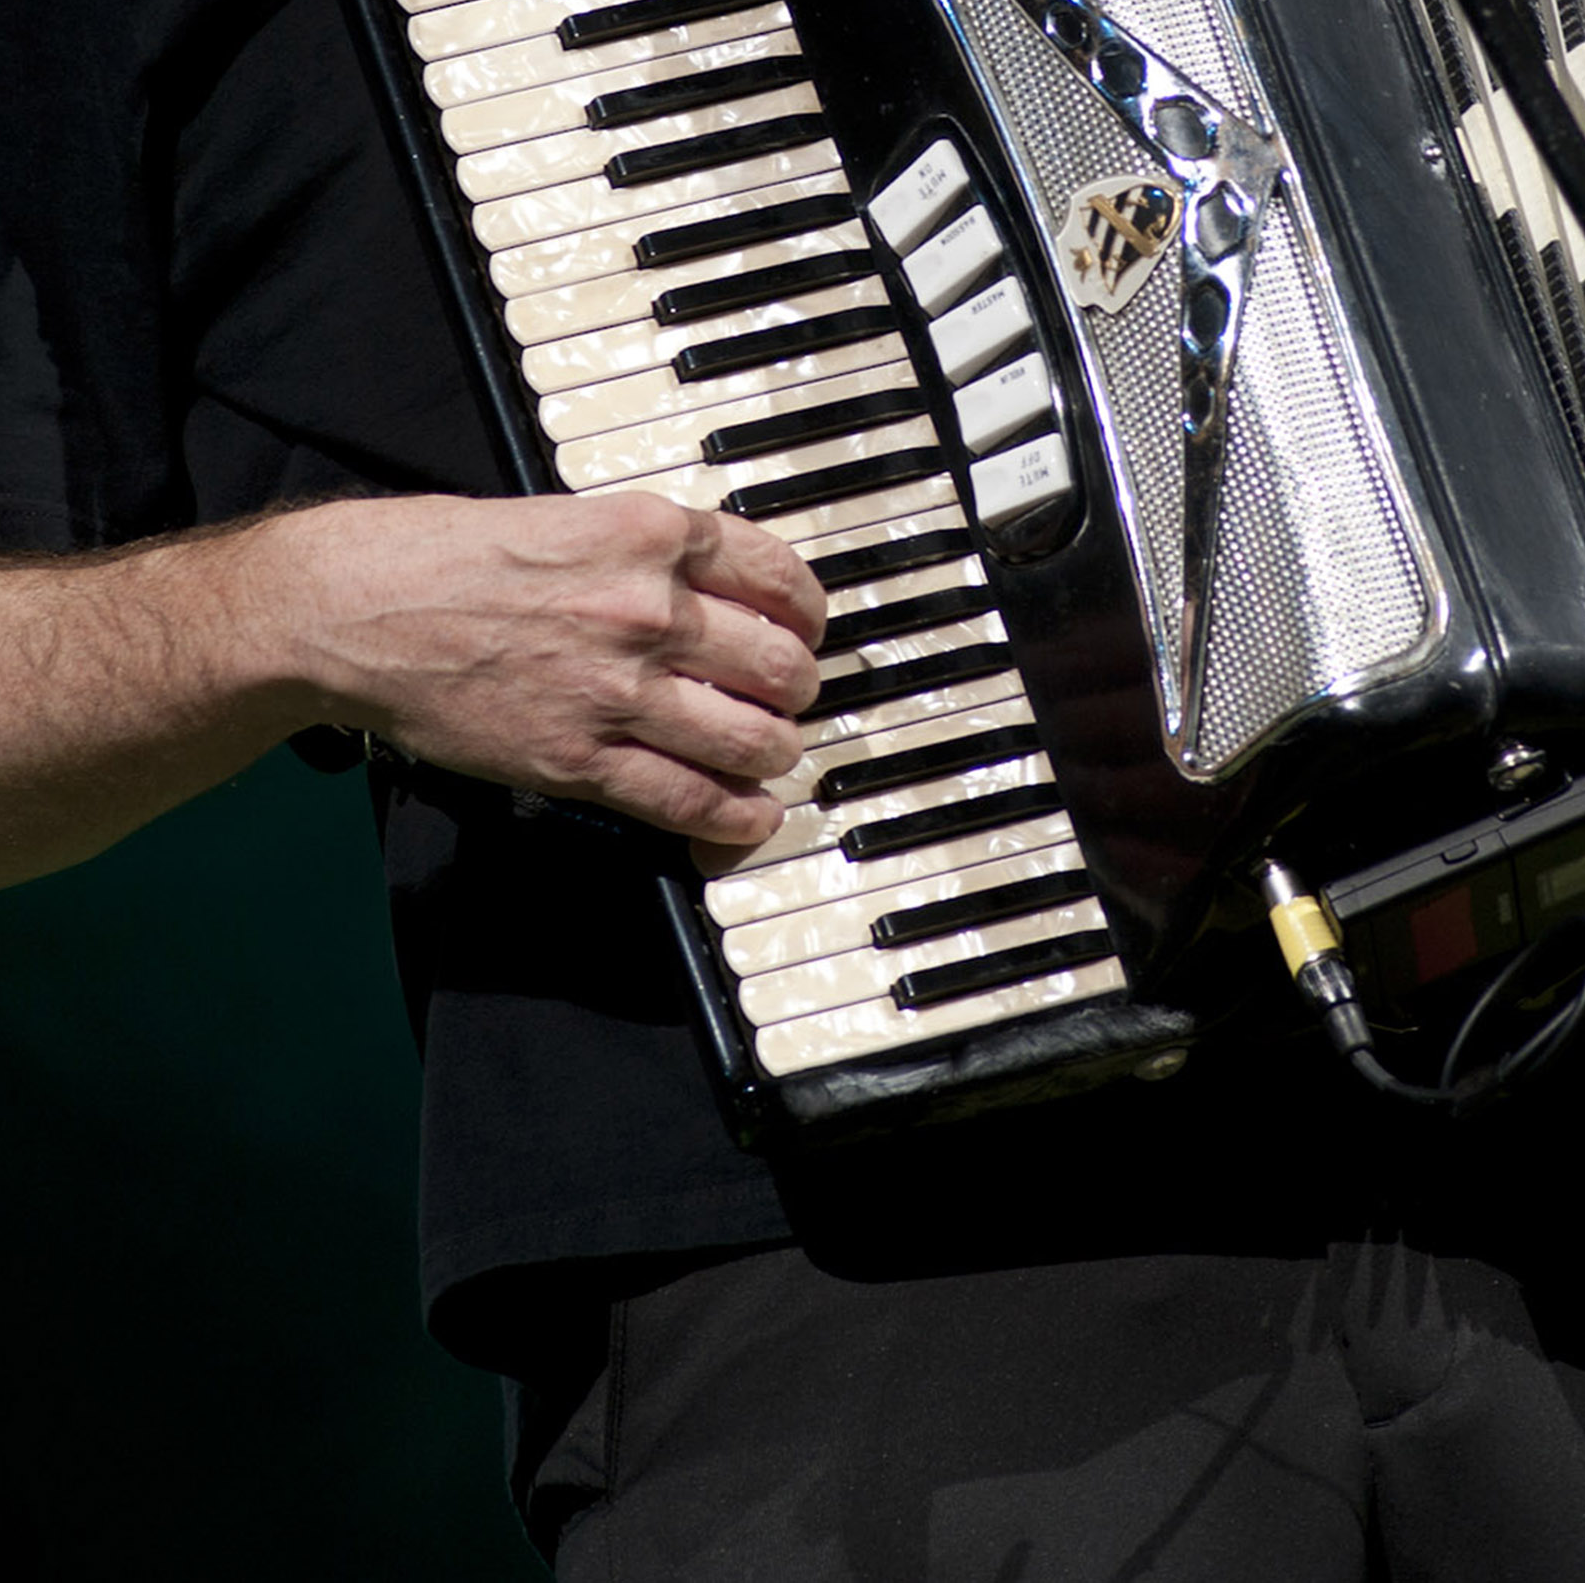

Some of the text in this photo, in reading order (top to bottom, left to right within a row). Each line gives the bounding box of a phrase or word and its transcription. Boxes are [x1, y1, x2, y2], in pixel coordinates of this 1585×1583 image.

[972, 290, 1005, 314] MASTER
[1020, 451, 1041, 469] OFF
[1019, 468, 1049, 488] MUTE
